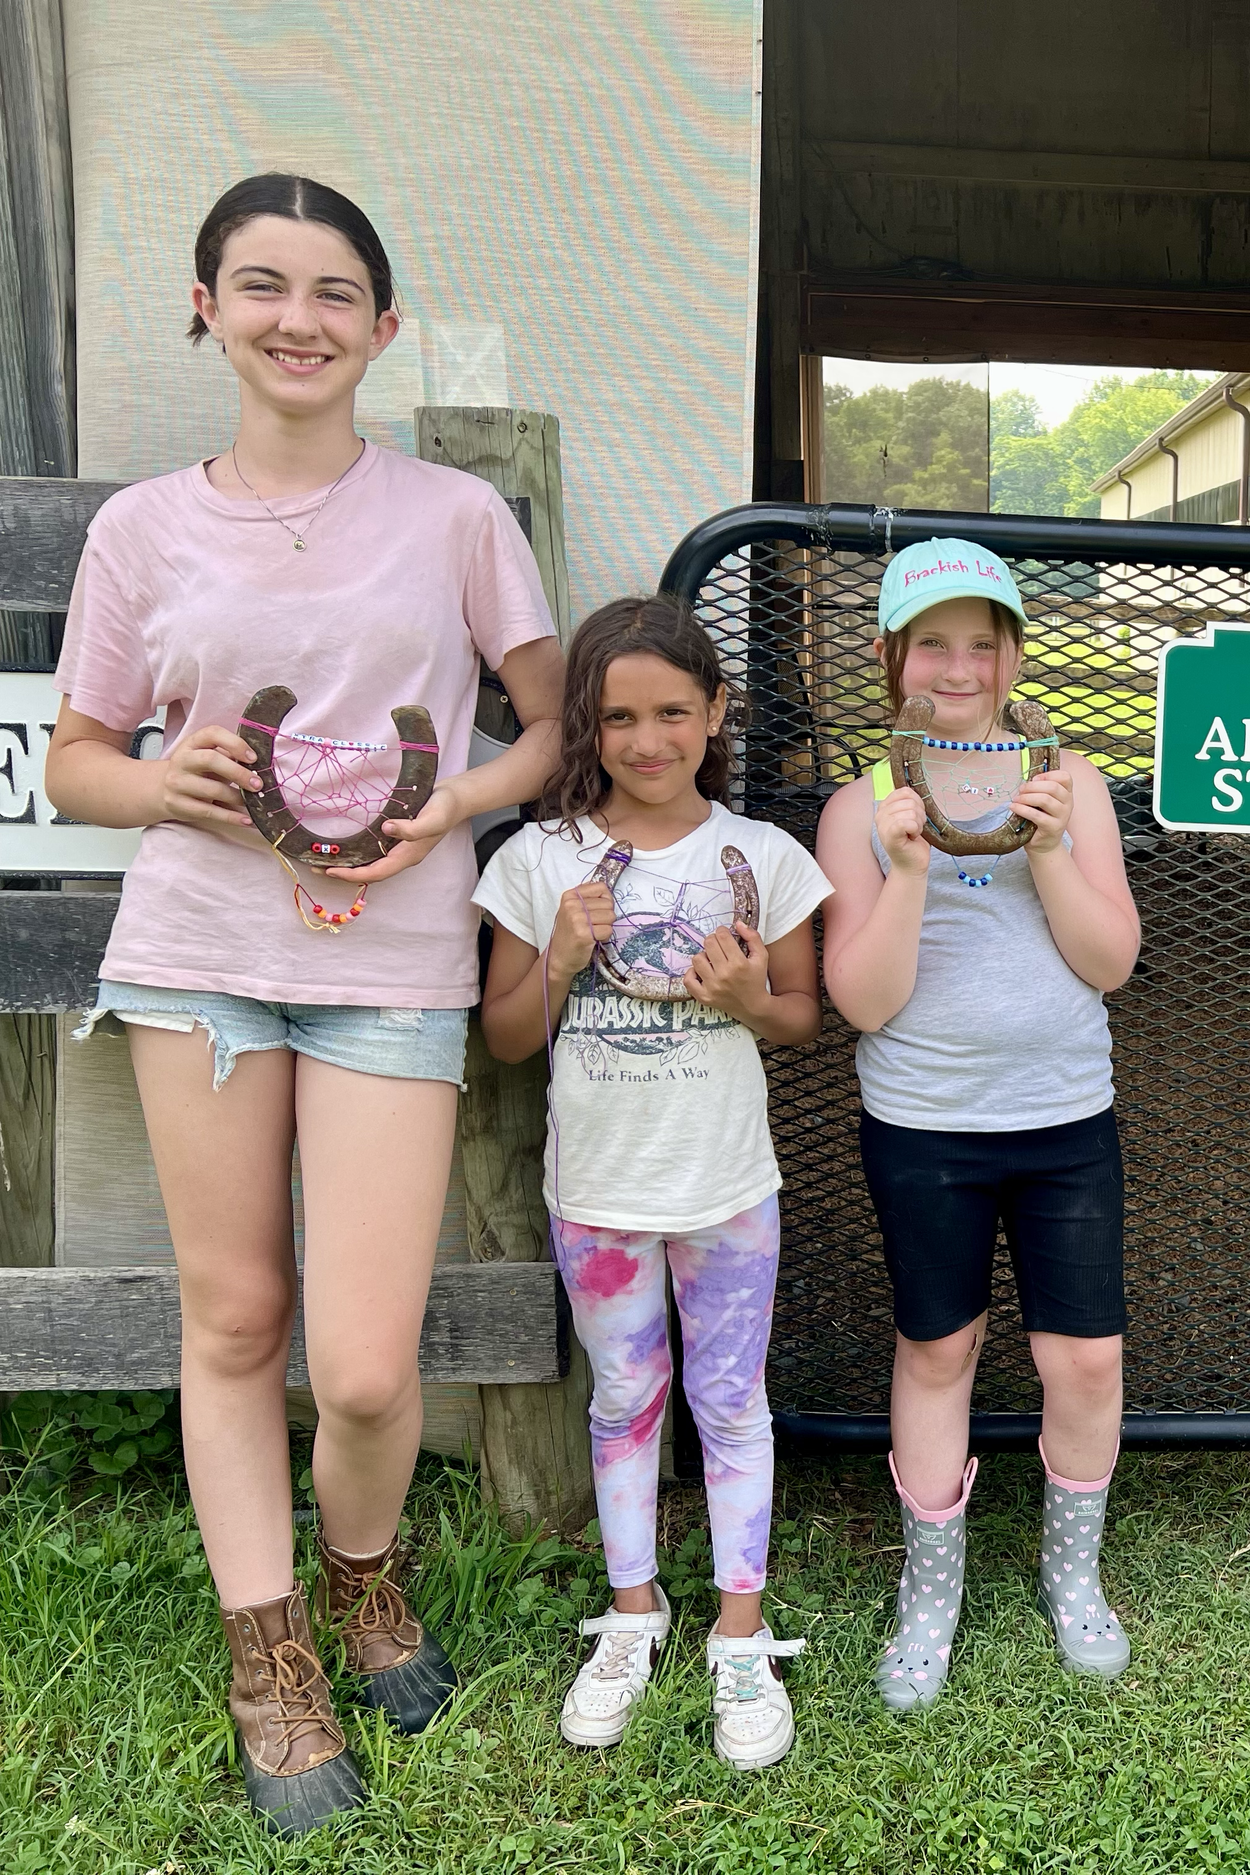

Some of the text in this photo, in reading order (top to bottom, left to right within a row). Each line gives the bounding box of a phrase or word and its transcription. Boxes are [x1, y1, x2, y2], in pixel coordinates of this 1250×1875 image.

[904, 559, 1002, 587] Brackish Life
[562, 994, 734, 1030] JURASSIC PAR
[588, 1067, 710, 1083] Life Finds A Way
